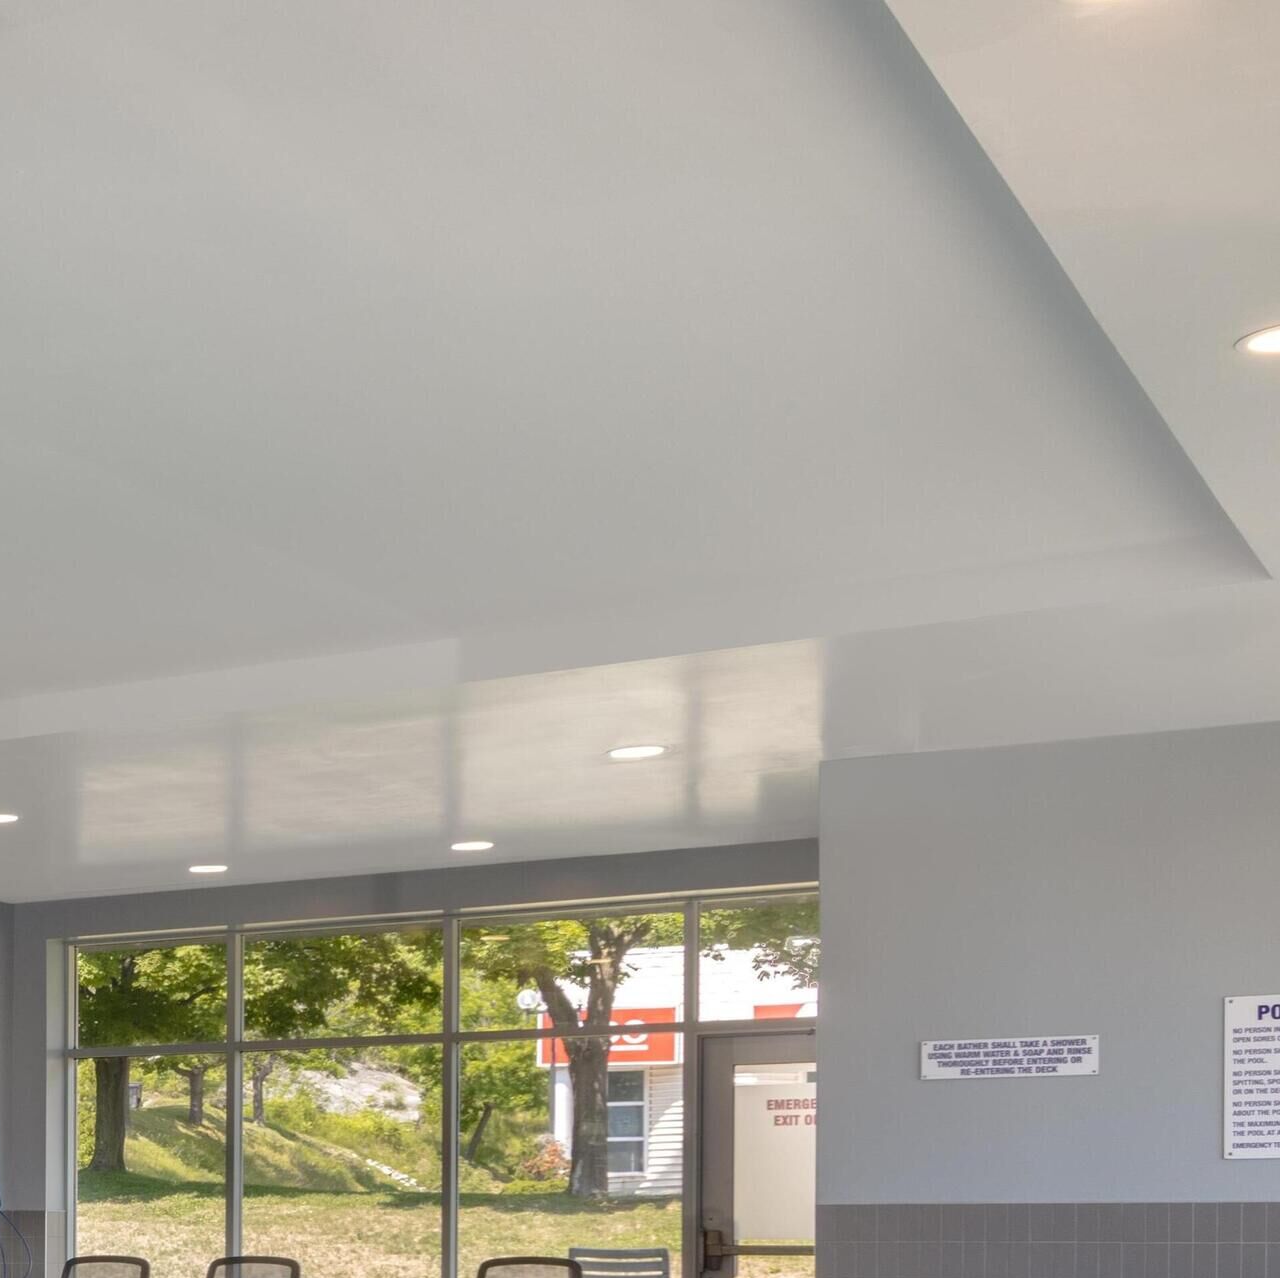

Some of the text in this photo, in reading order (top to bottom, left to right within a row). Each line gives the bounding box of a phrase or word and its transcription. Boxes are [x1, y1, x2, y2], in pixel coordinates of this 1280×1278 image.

[933, 1043, 955, 1051] EACH
[957, 1042, 988, 1050] BATHER
[991, 1041, 1017, 1049] SHALL
[1020, 1040, 1040, 1048] TAKE
[1050, 1039, 1087, 1047] SHOWER
[928, 1052, 953, 1060] USING
[954, 1051, 981, 1059] WARM
[983, 1049, 1011, 1058] WATER
[1067, 1047, 1093, 1055] RINSE
[937, 1056, 1083, 1068] THOROUGHLY BEFORE ENTERING OR
[960, 1065, 1058, 1076] RE-ENTERING THE DECK
[774, 1115, 800, 1126] EXIT
